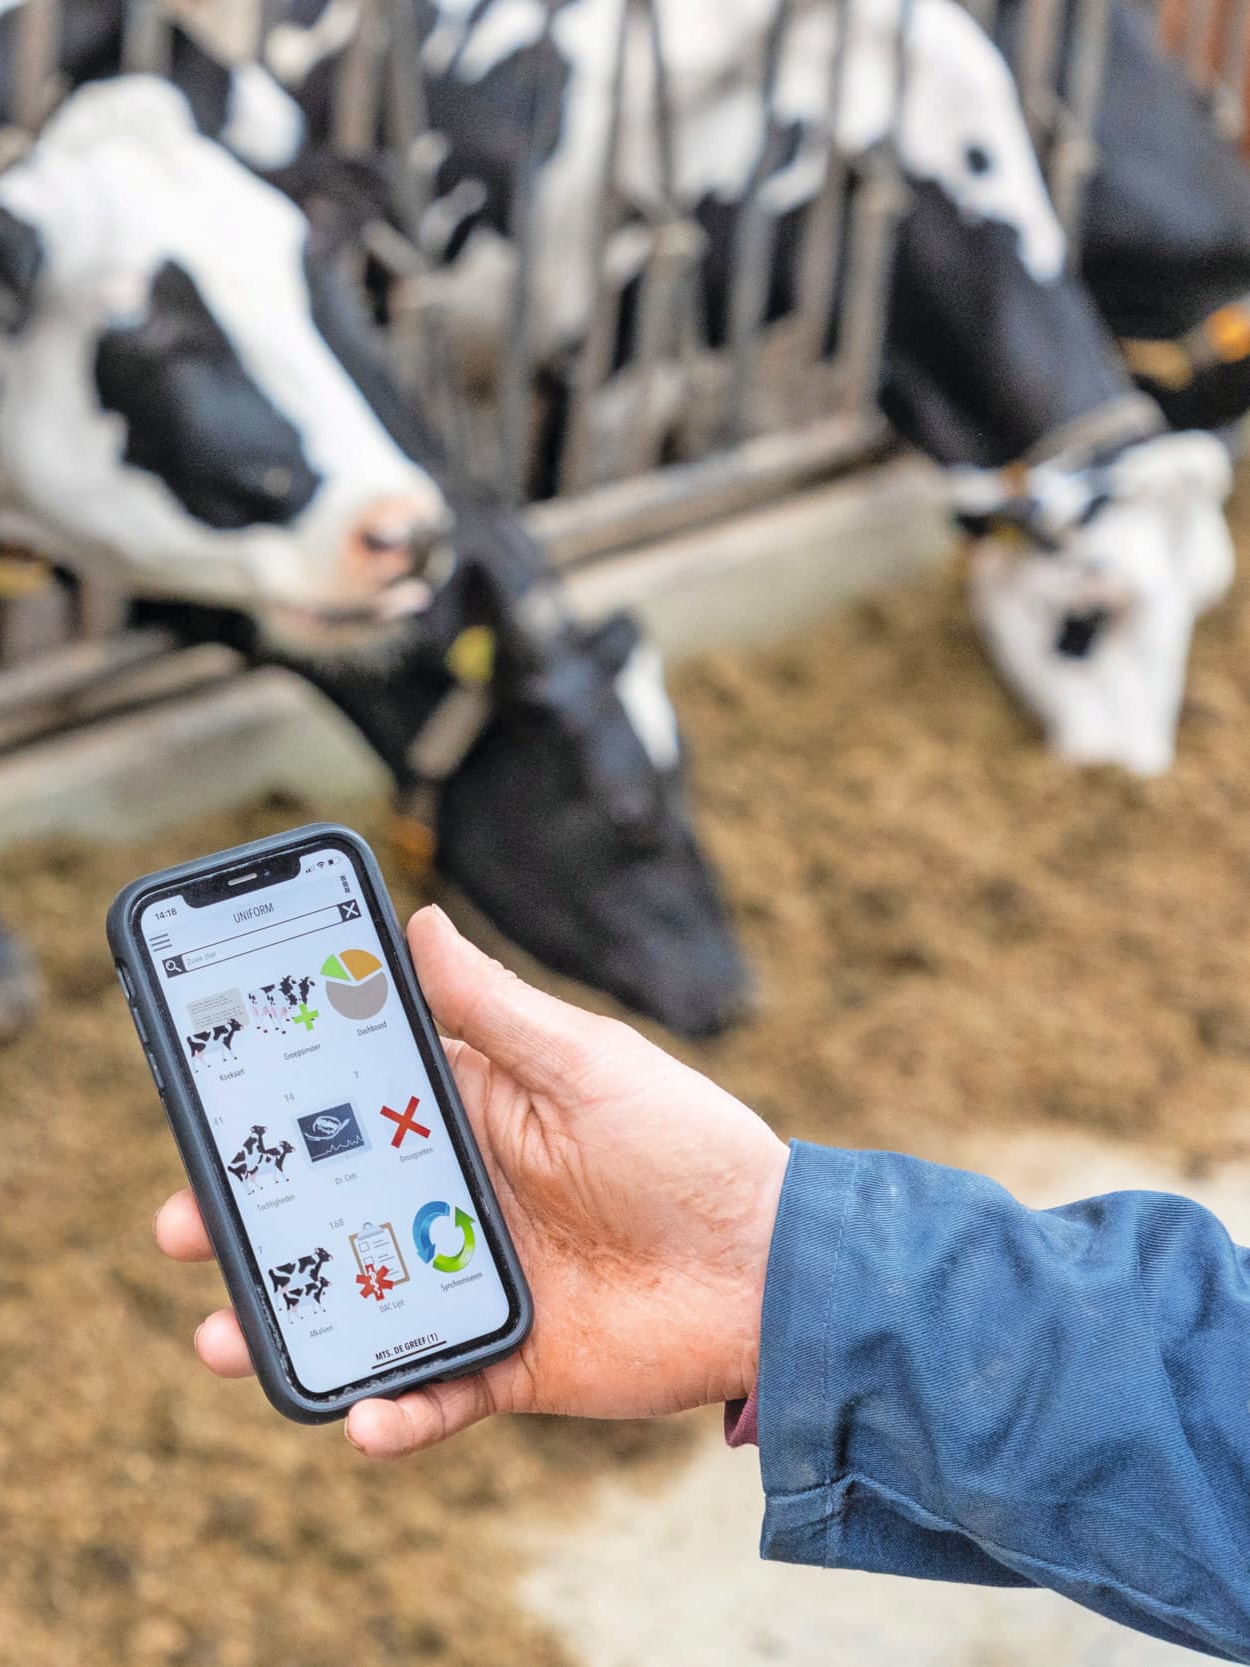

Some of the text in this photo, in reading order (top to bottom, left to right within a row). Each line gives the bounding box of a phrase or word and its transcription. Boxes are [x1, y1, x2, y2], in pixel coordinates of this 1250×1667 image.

[155, 908, 177, 920] 14:18
[233, 902, 275, 923] UNIFORM
[356, 1021, 388, 1036] Dashboard
[219, 1068, 245, 1081] Koekaart
[284, 1093, 295, 1103] 14
[329, 1218, 345, 1230] 168
[375, 1332, 439, 1361] MTS. DE GREEF (1)
